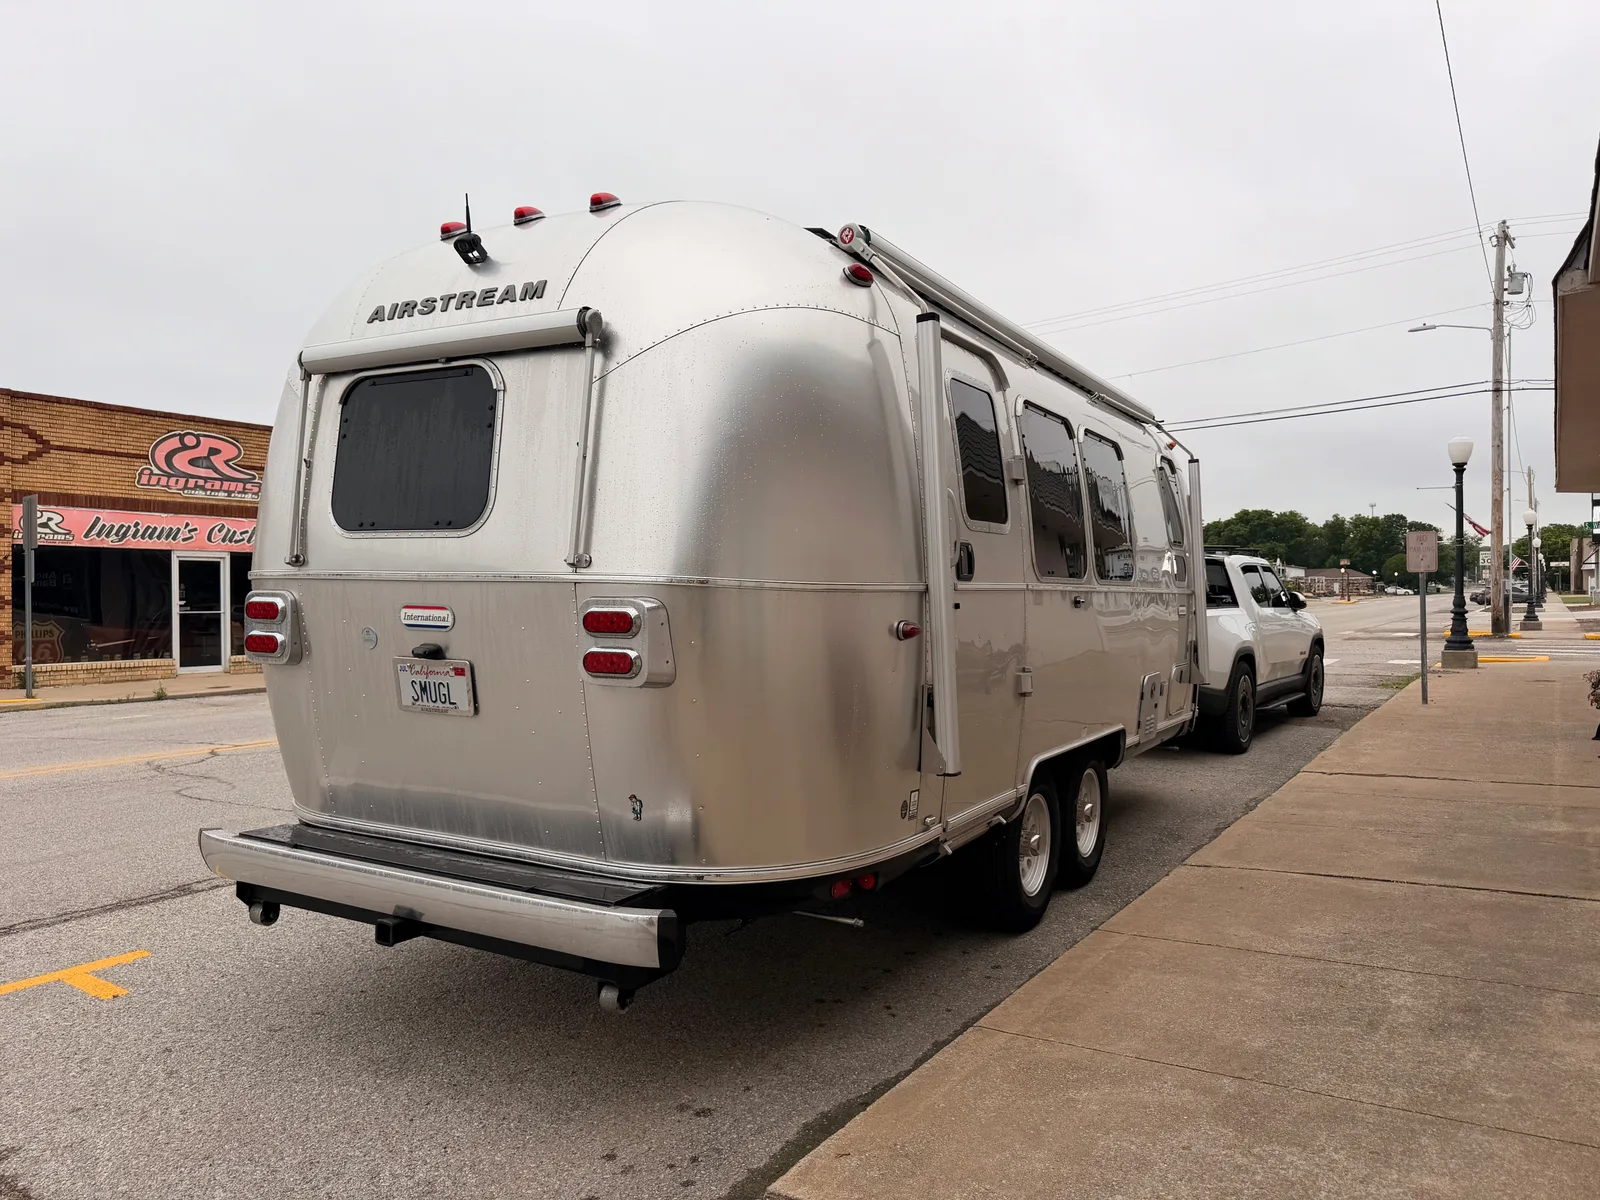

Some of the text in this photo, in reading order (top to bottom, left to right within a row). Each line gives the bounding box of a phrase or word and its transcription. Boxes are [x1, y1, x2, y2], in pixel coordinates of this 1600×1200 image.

[366, 279, 548, 323] AIRSTREAM
[138, 469, 261, 493] ingrams
[82, 515, 199, 543] Ingram's
[403, 612, 451, 623] International
[15, 630, 54, 639] PHLLIPS
[409, 663, 450, 680] California
[410, 679, 458, 706] SMUGL
